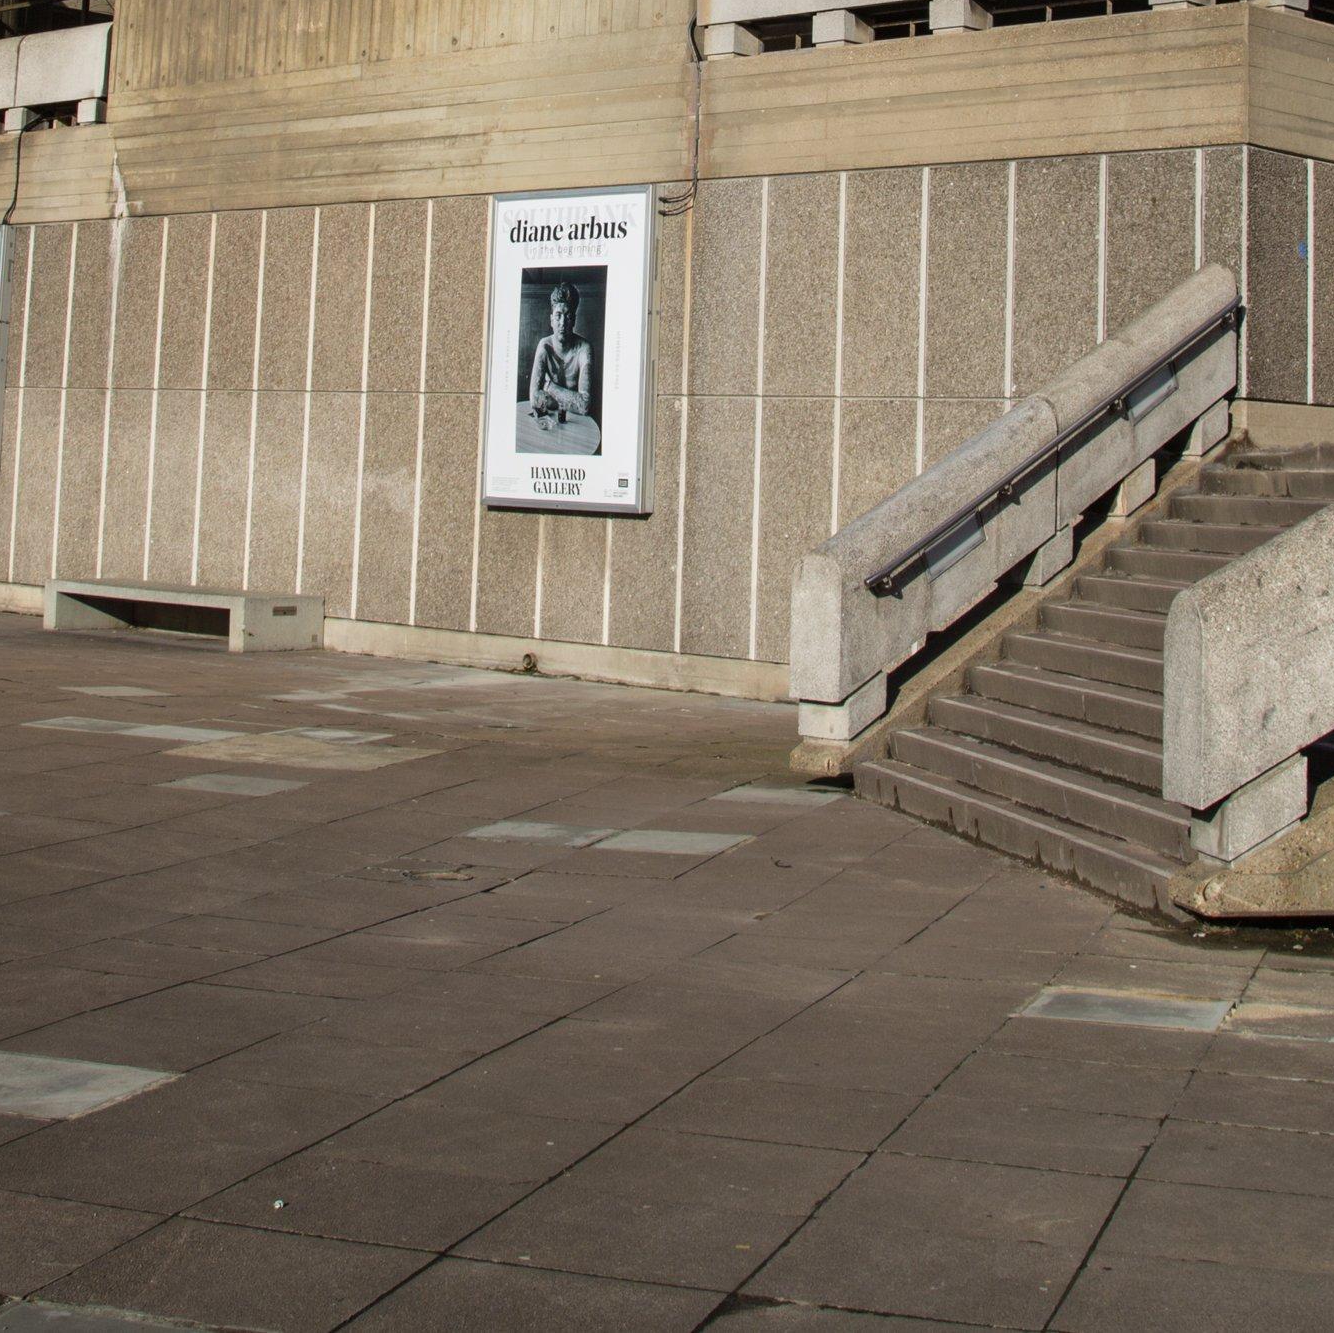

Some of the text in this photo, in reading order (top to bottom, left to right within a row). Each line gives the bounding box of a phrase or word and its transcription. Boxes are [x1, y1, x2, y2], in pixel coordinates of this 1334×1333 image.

[509, 215, 628, 244] diane arbus
[557, 243, 603, 257] beginning
[530, 466, 586, 482] HAYWARD
[533, 481, 583, 496] GALLERY
